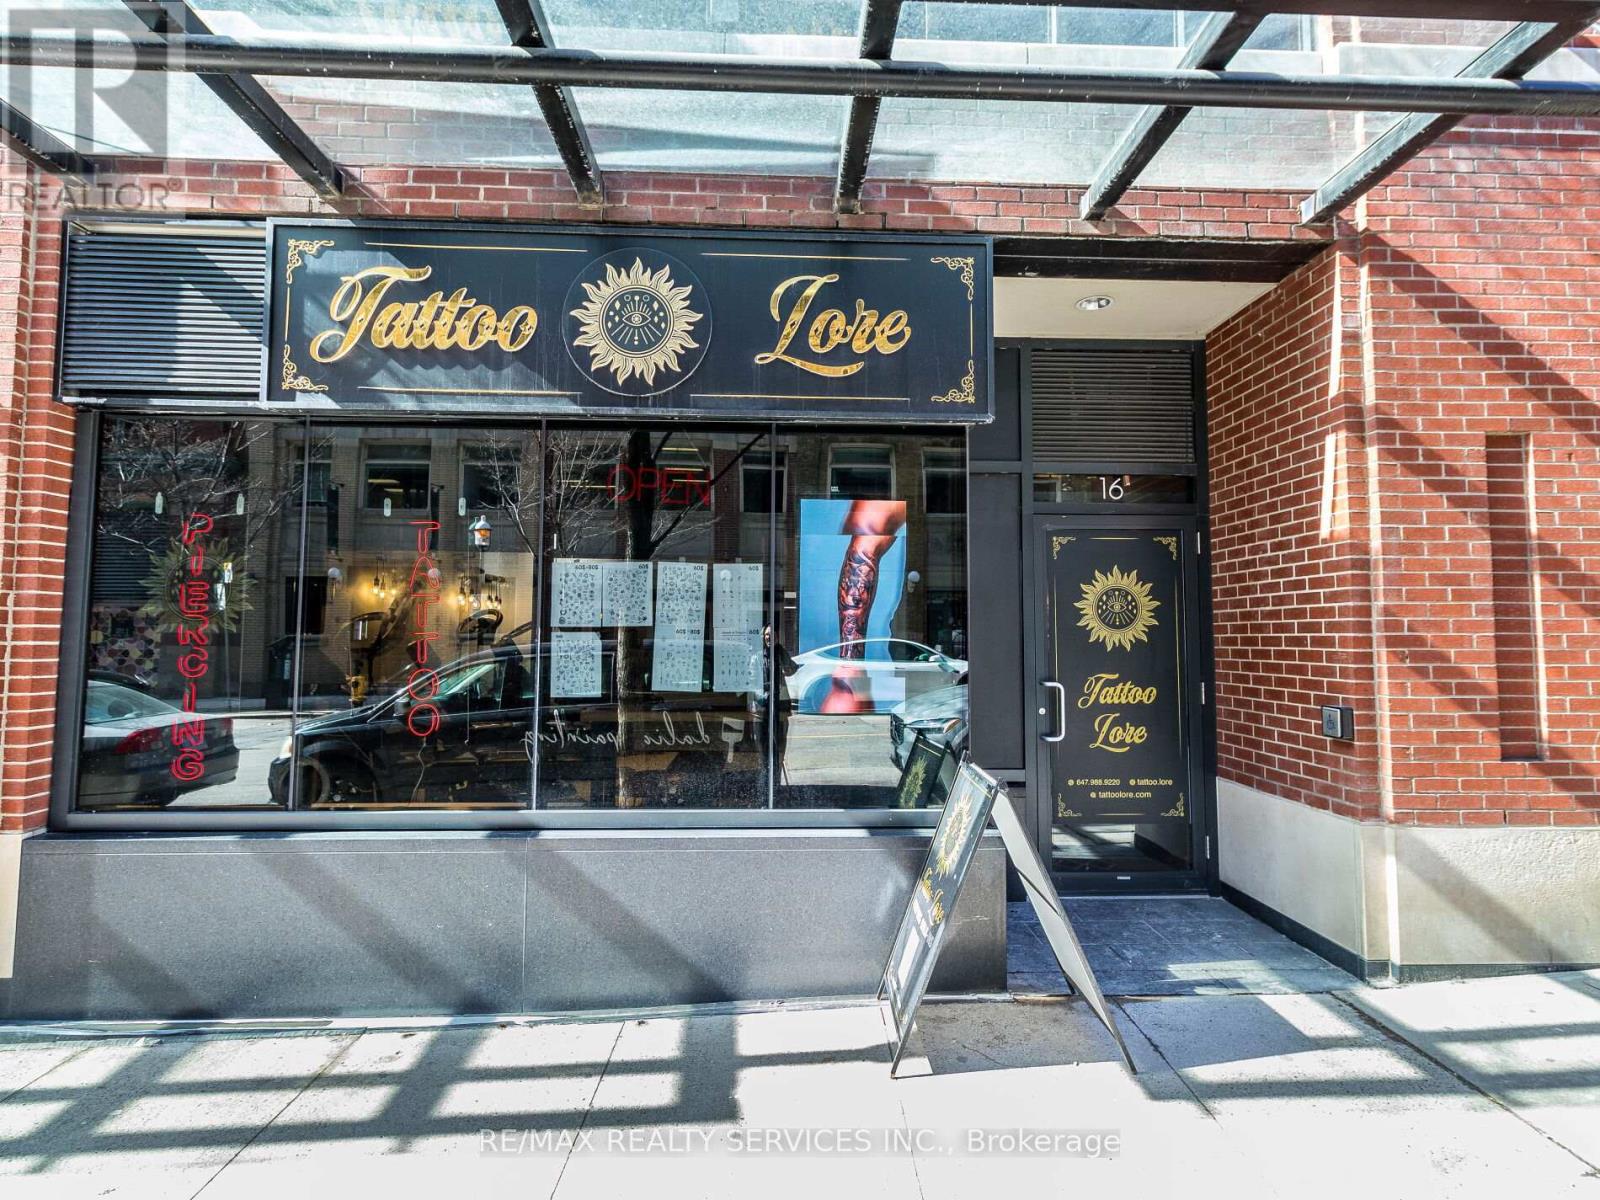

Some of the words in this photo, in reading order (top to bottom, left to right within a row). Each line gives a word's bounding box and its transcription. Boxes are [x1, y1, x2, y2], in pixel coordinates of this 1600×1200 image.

[309, 265, 538, 364] Tattoo
[754, 273, 912, 377] Lore
[607, 464, 712, 507] OPEN
[1099, 476, 1124, 500] 16
[171, 512, 214, 781] PIERCING
[407, 521, 441, 737] TATTOO
[1077, 673, 1157, 709] Tattoo
[1089, 713, 1148, 753] Lore
[1098, 790, 1152, 799] tattoolore.com
